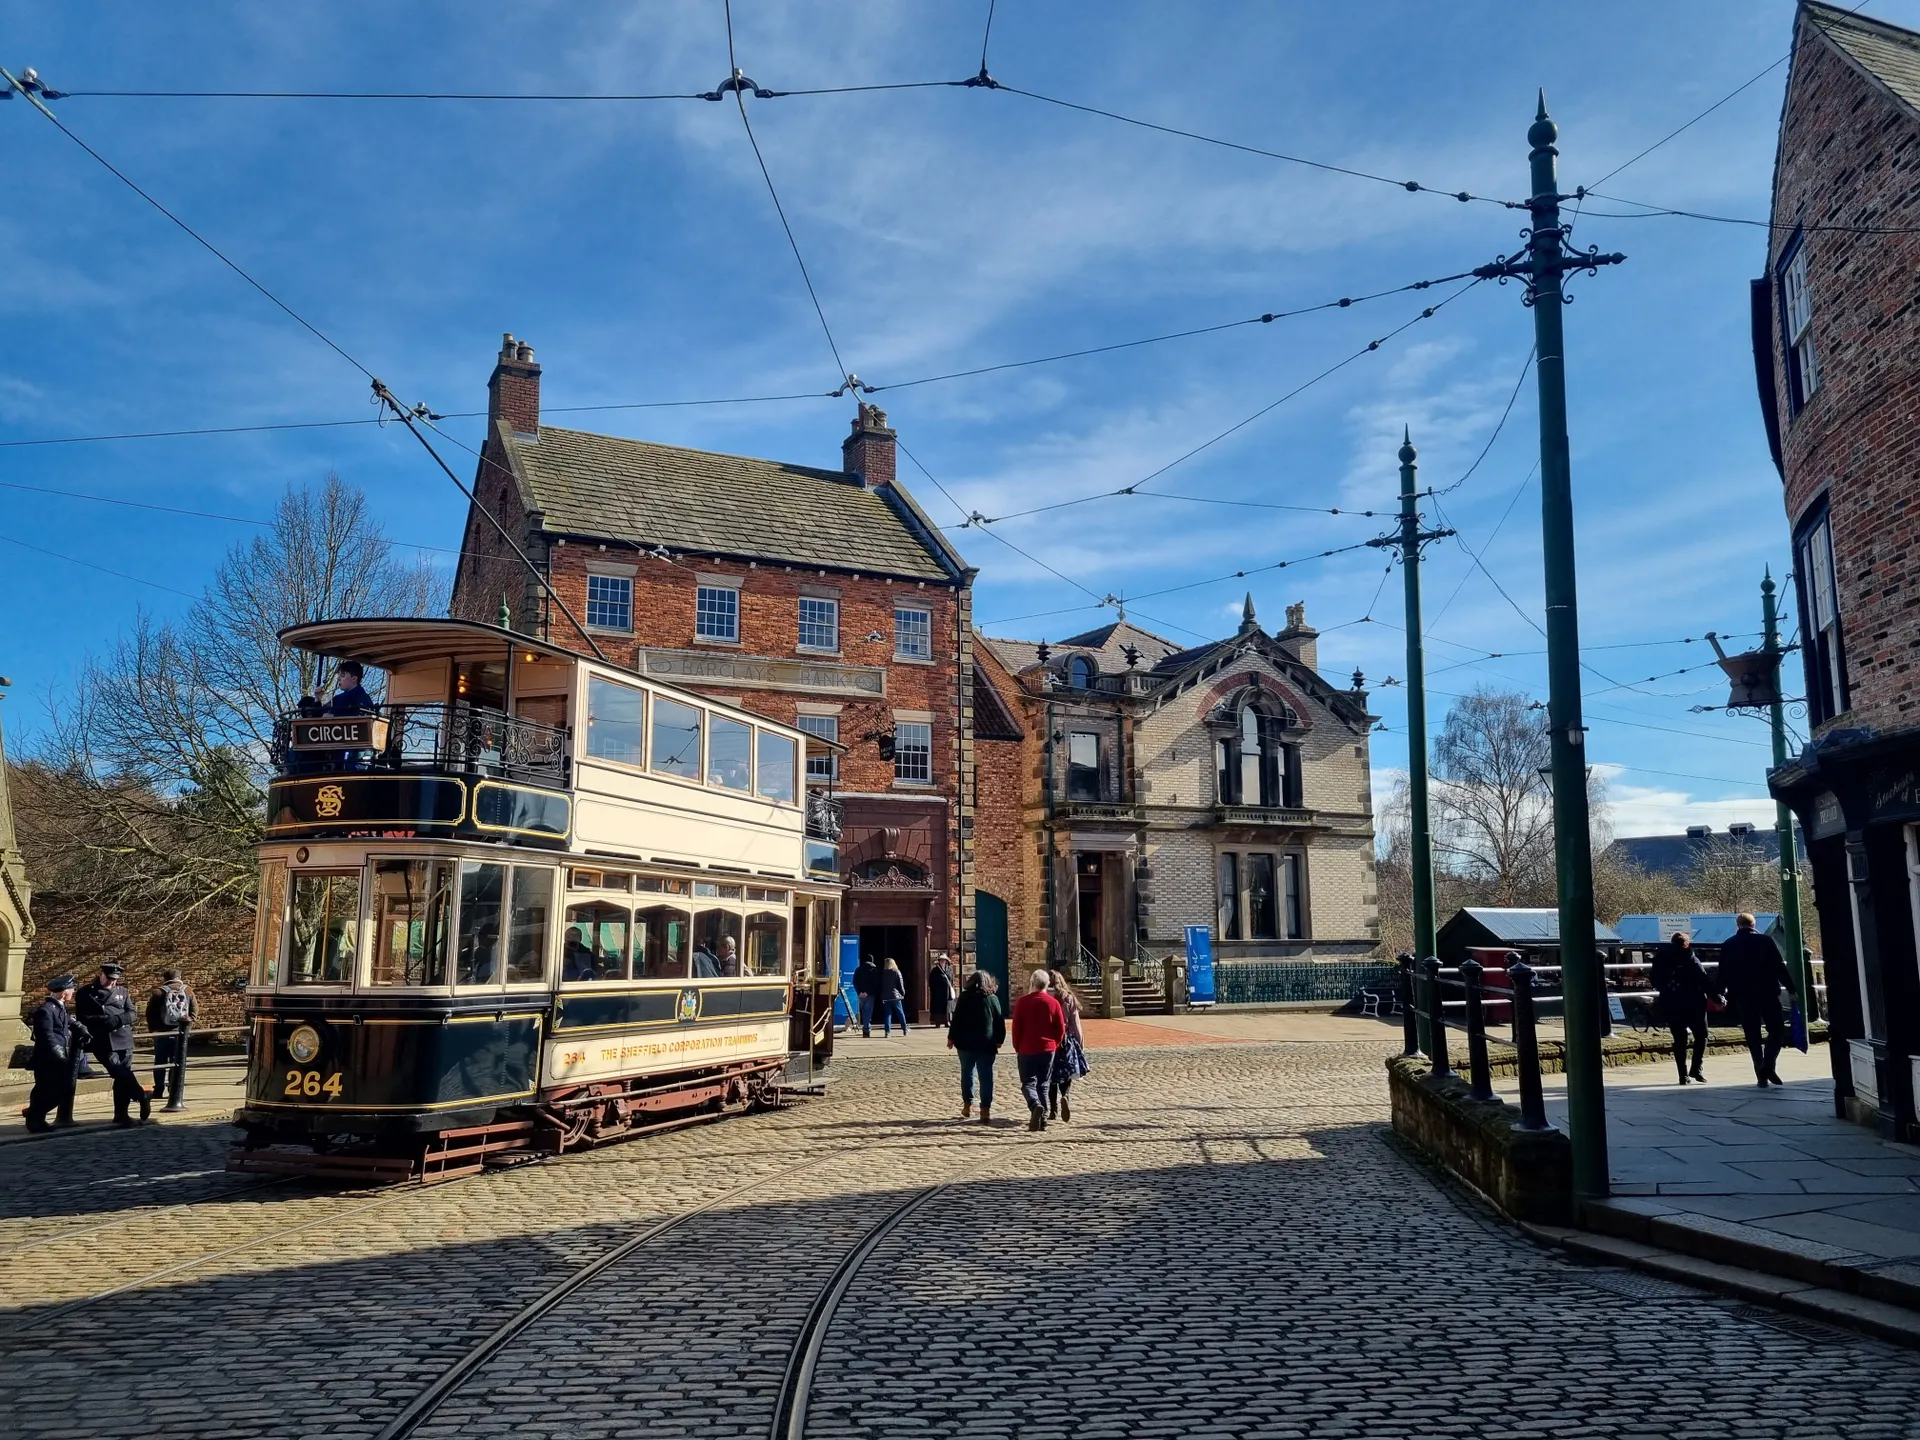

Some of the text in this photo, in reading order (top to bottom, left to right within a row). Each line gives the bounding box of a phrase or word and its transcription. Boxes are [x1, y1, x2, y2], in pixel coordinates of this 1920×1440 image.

[682, 659, 847, 687] BARCLAYS BANK
[308, 724, 359, 742] CIRCLE
[601, 1048, 617, 1060] THE
[620, 1043, 667, 1058] SHEFFIELD
[669, 1036, 723, 1053] CORPORATION
[723, 1033, 758, 1047] TRAMWAYS
[284, 1070, 343, 1096] 264
